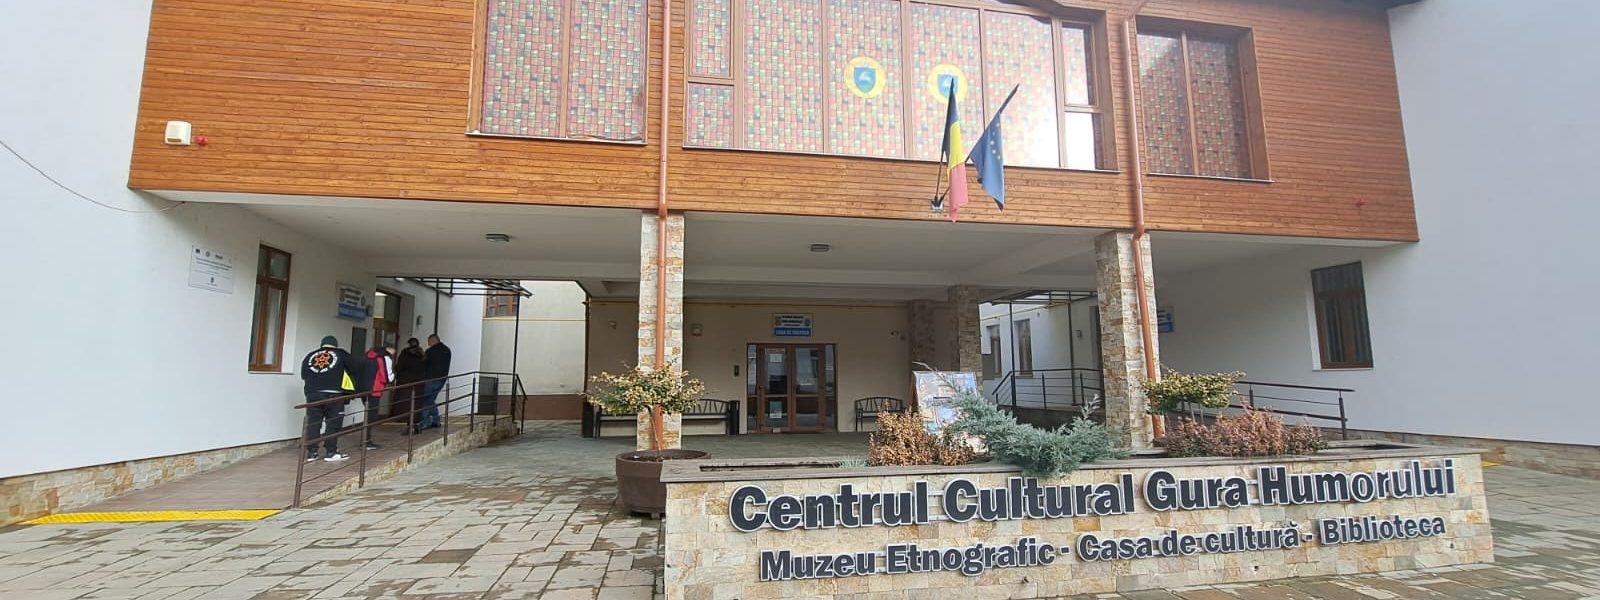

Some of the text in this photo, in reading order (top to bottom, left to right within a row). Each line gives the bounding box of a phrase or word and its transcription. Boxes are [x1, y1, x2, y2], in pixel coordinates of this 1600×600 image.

[729, 459, 1457, 532] Centrul Cultural Gura Humorului
[760, 550, 876, 581] Muzeu
[886, 536, 1055, 576] Etnografic
[1077, 534, 1153, 561] Casa
[1158, 530, 1197, 556] de
[1205, 521, 1299, 551] cultură
[1319, 514, 1446, 545] Biblioteca
